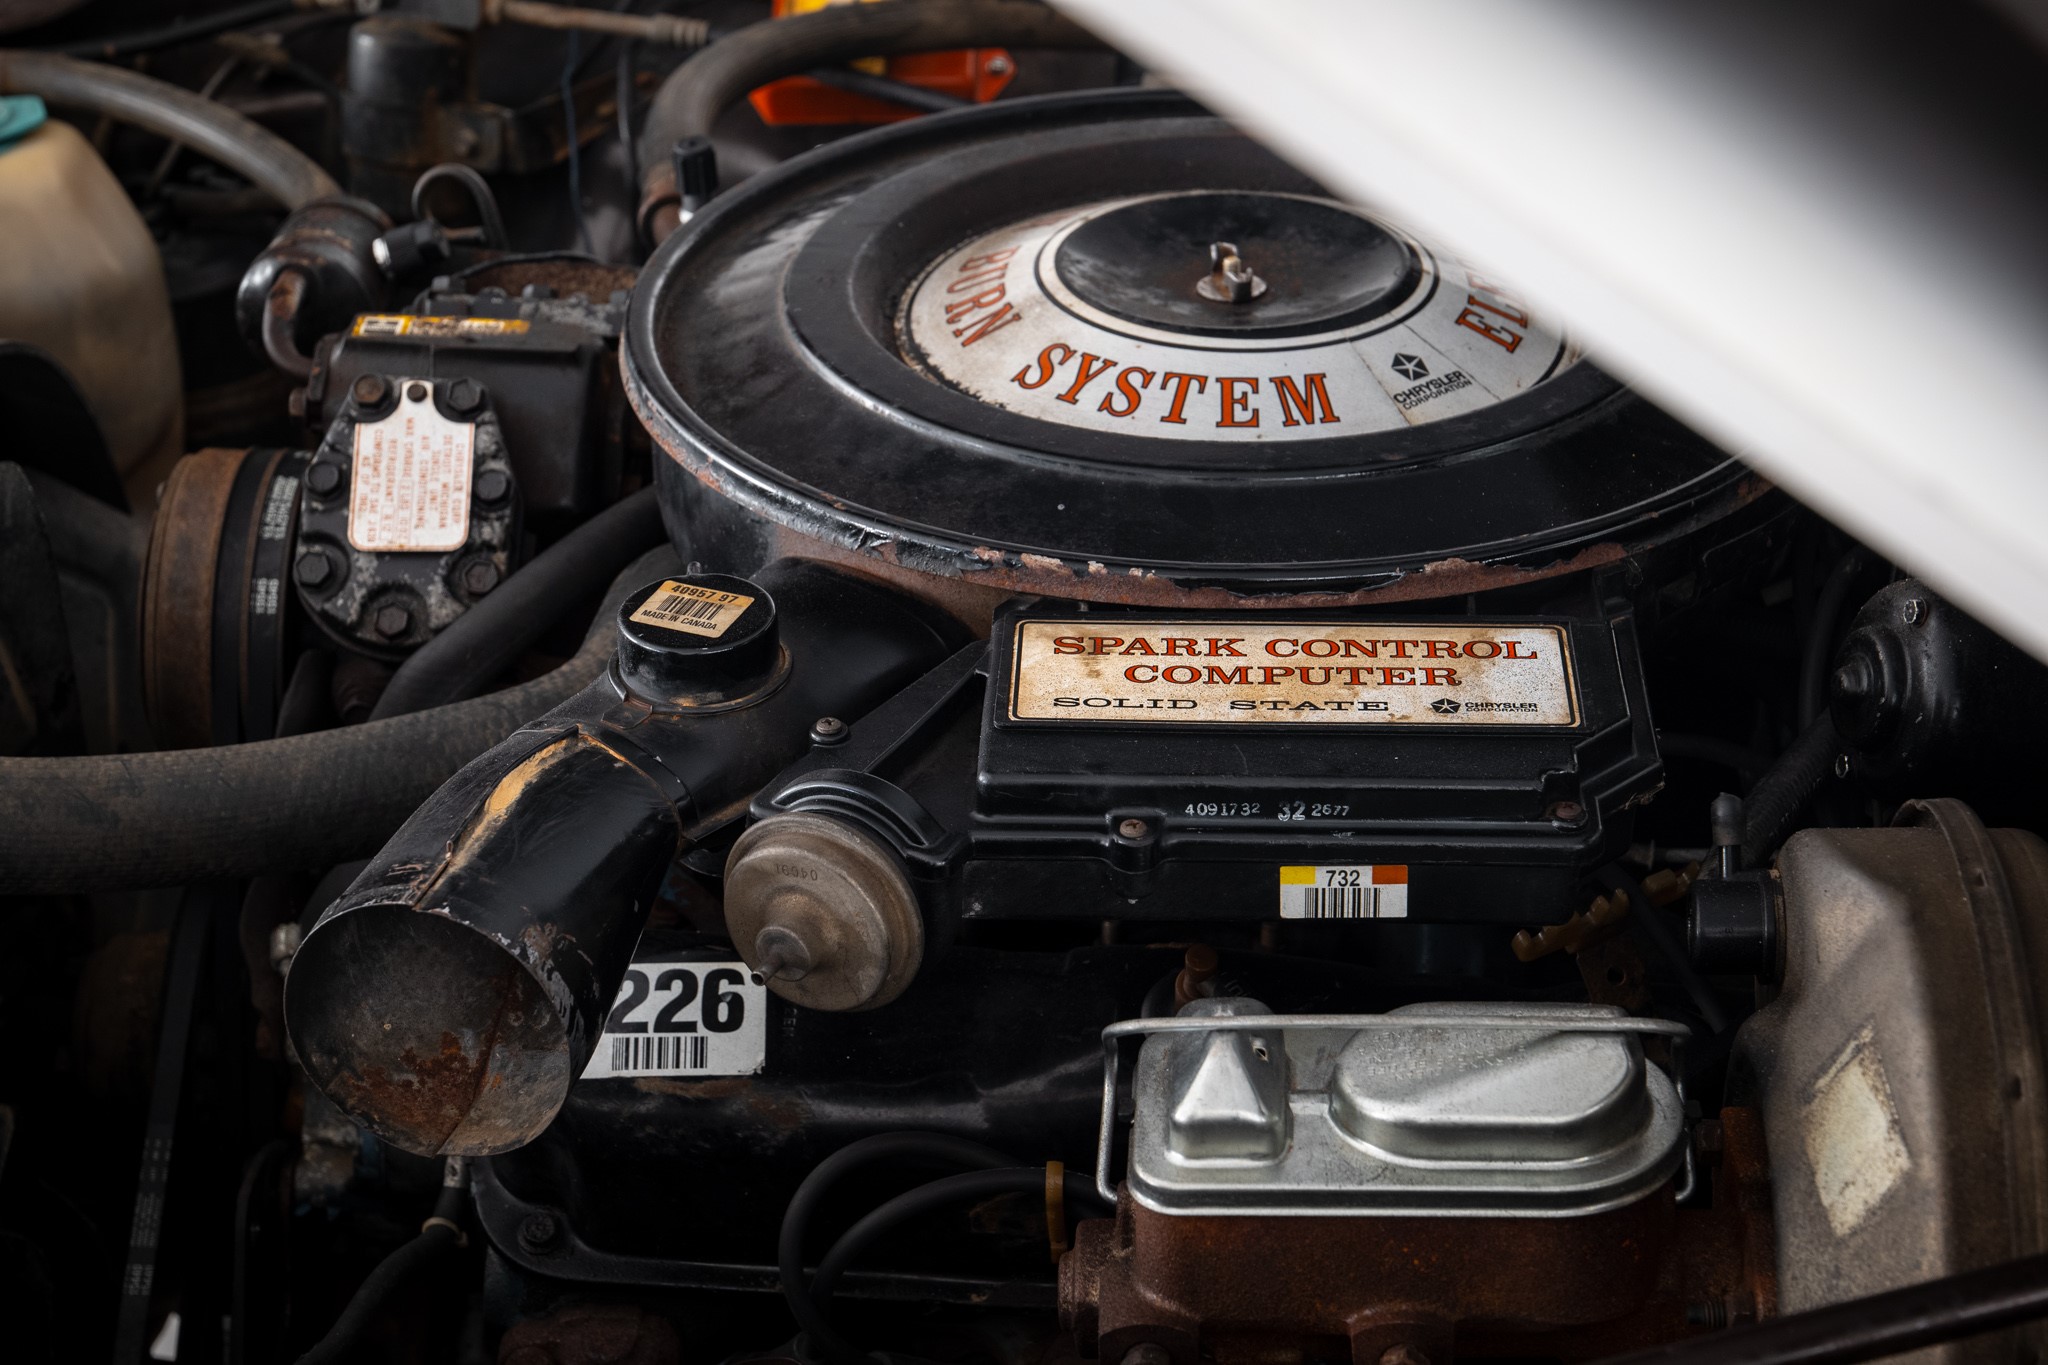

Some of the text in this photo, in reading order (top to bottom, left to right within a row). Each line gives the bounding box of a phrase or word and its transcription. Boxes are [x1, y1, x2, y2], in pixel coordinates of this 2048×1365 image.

[1010, 342, 1341, 429] SYSTEM
[1393, 370, 1467, 404] CHRYSLER
[1402, 379, 1473, 411] CORPORATION
[443, 434, 453, 474] DETROIT
[671, 584, 740, 605] 40957 97
[641, 609, 718, 631] MADE IN CANADA
[1053, 636, 1538, 660] SPARK CONTROL
[1124, 665, 1463, 687] COMPUTER
[1053, 696, 1390, 712] SOLID STATE
[1464, 701, 1539, 709] CHRYSLER
[1185, 802, 1261, 816] 4091732
[1311, 803, 1351, 817] 2677
[1325, 870, 1361, 887] 732
[604, 968, 745, 1033] 226
